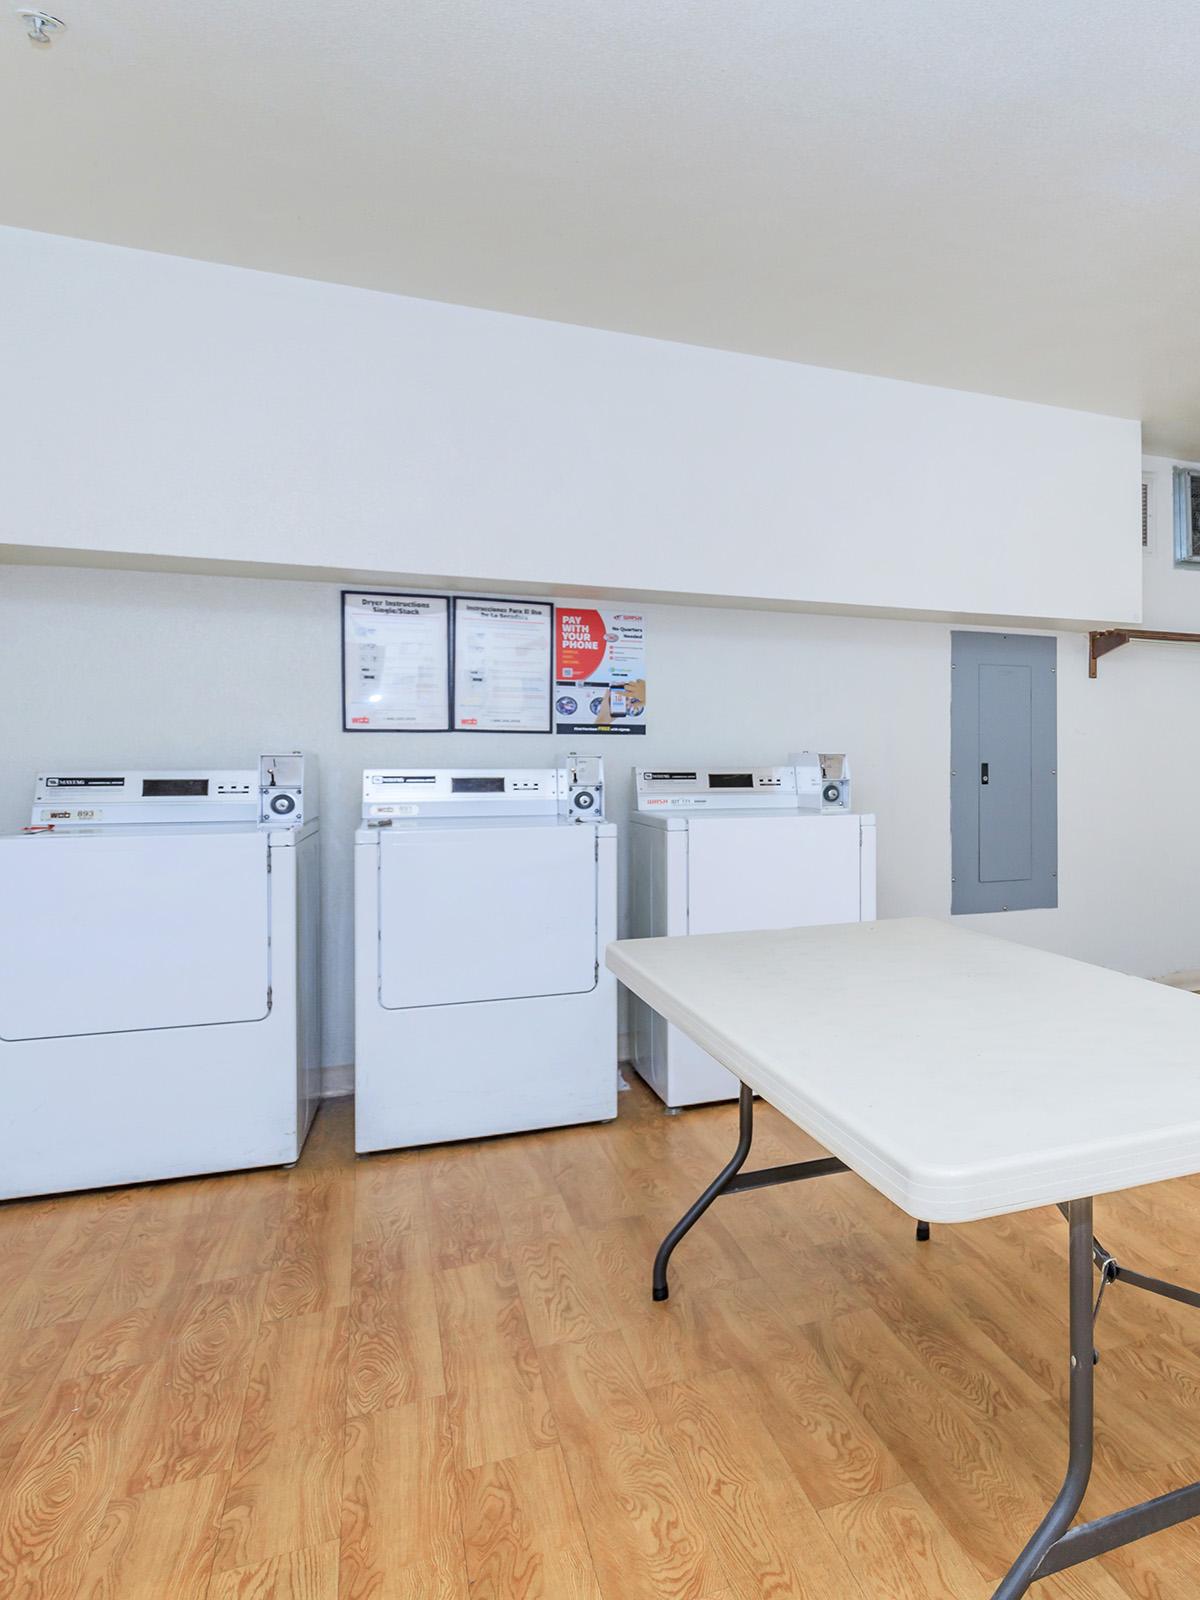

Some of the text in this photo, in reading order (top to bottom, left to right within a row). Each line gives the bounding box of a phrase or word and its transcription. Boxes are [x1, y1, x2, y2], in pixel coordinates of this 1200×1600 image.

[385, 600, 430, 608] Instructions
[562, 616, 582, 624] PAY
[562, 624, 589, 632] WITH
[562, 632, 591, 641] YOUR
[562, 640, 598, 650] PHONE
